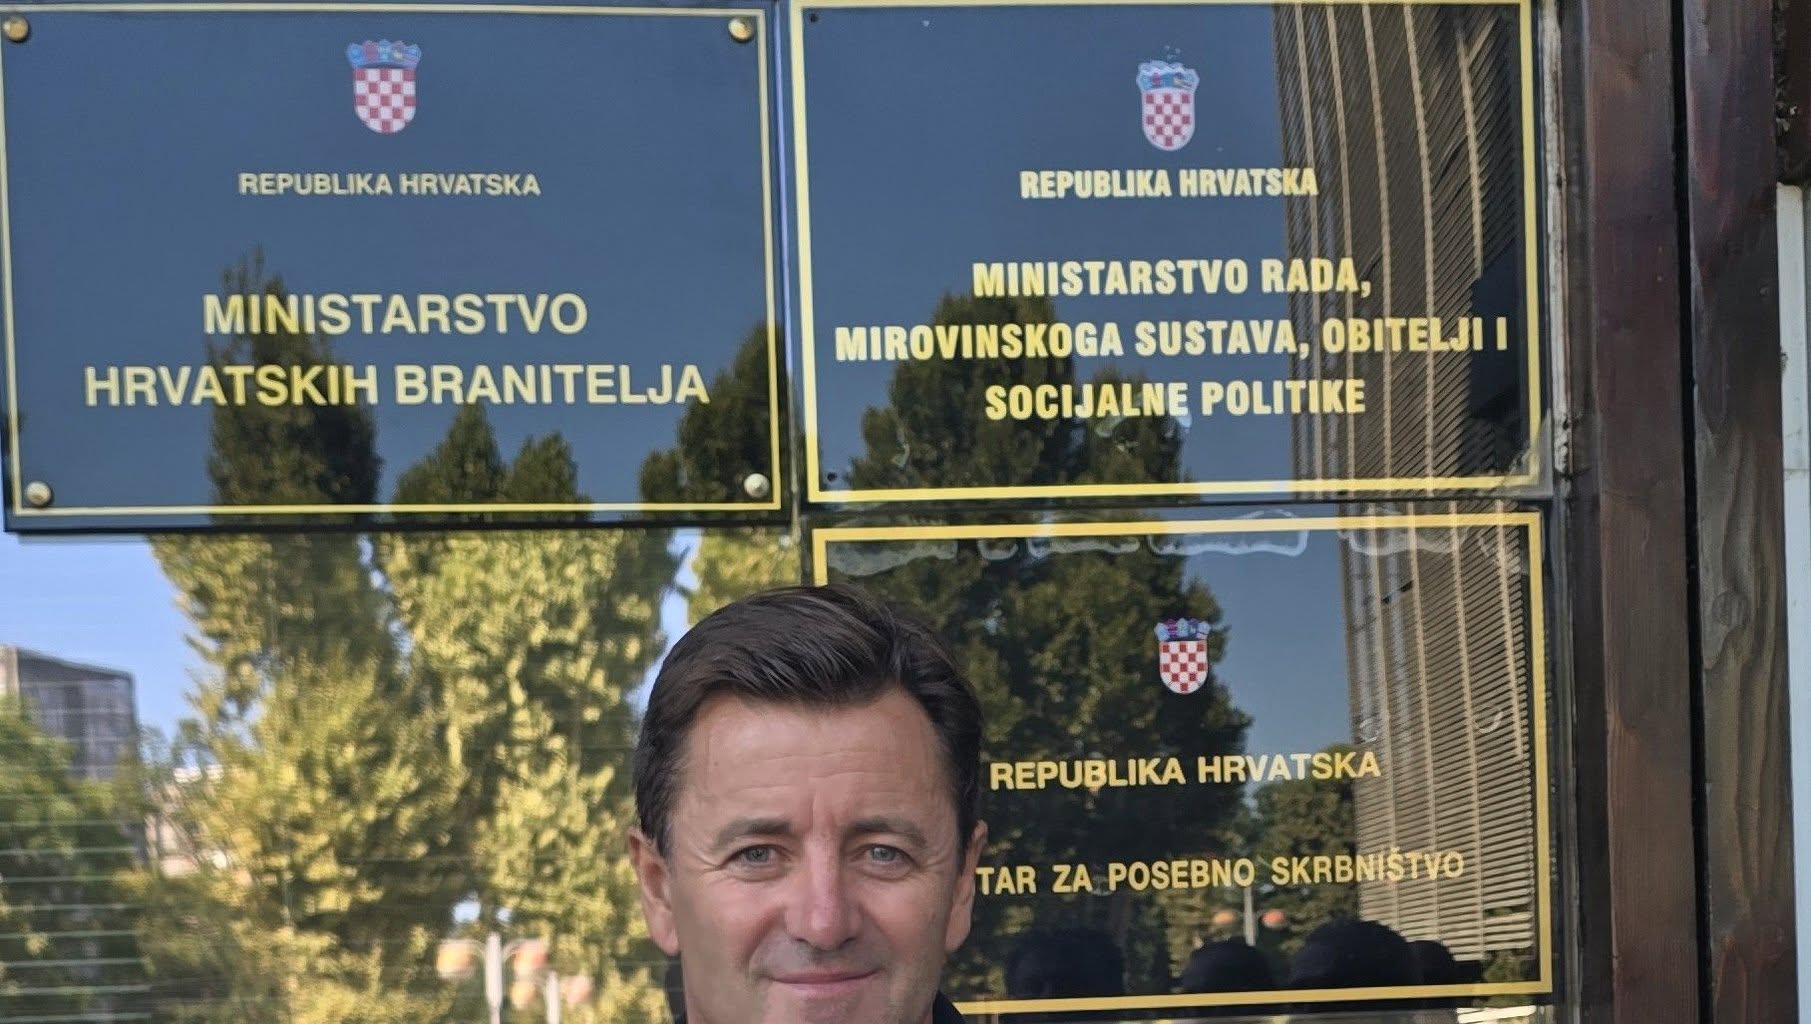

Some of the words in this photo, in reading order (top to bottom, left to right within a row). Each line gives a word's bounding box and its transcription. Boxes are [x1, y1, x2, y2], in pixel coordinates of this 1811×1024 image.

[239, 172, 393, 197] REPUBLIKA
[400, 172, 541, 197] HRVATSKA
[1020, 169, 1172, 200] REPUBLIKA
[1180, 166, 1319, 198] HRVATSKA
[972, 260, 1248, 298] MINISTARSTVO
[1265, 257, 1371, 299] RADA,
[203, 293, 588, 336] MINISTARSTVO
[835, 322, 1124, 362] MIROVINSKOGA
[1135, 319, 1310, 360] SUSTAVA,
[1322, 317, 1484, 352] OBITELJI
[1497, 316, 1508, 351] I
[84, 365, 380, 407] HRVATSKIH
[396, 363, 711, 405] BRANITELJA
[985, 381, 1189, 421] SOCIJALNE
[1201, 379, 1366, 415] POLITIKE
[990, 756, 1186, 791] REPUBLIKA
[1197, 751, 1381, 784] HRVATSKA
[975, 865, 1037, 896] TAR
[1052, 864, 1093, 894] ZA
[1107, 857, 1255, 892] POSEBNO
[1271, 847, 1465, 885] SKRBNIŠTVO
